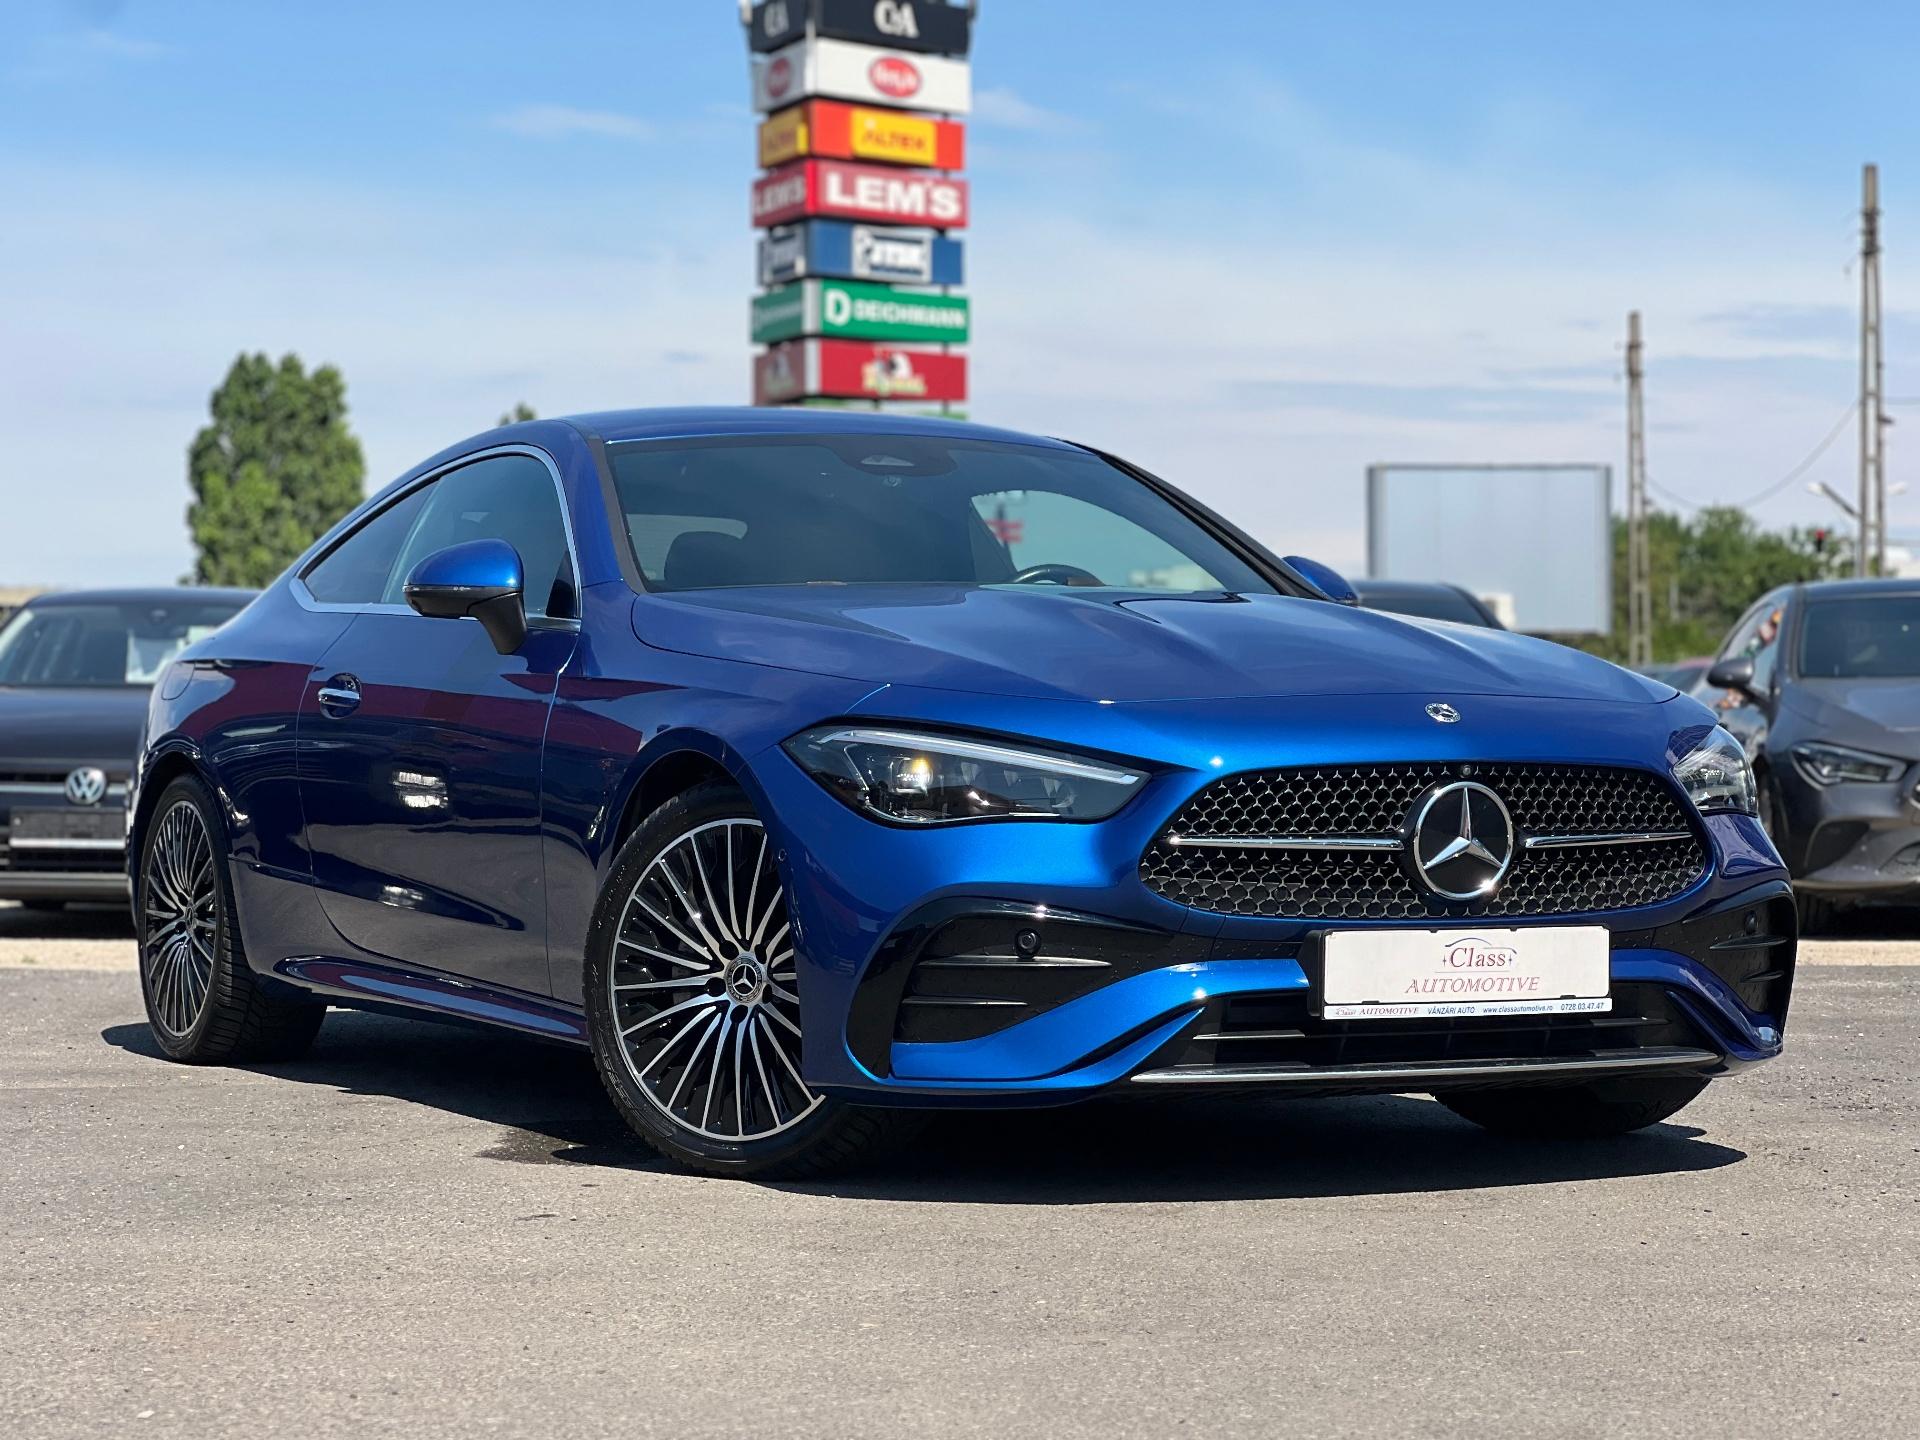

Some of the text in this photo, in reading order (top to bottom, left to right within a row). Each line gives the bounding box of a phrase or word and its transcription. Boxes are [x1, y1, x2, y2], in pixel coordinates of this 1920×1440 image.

[825, 172, 961, 219] LEM'S
[854, 297, 965, 329] DEICHMANN
[1449, 947, 1506, 967] Class
[1405, 976, 1540, 993] AUTOMOTIVE
[1360, 1007, 1418, 1016] AUTOMOTIVE
[1457, 1006, 1475, 1014] AUTO
[1483, 1005, 1553, 1014] www.classautomotive.ro
[1561, 1002, 1604, 1011] 0728.03.47.47
